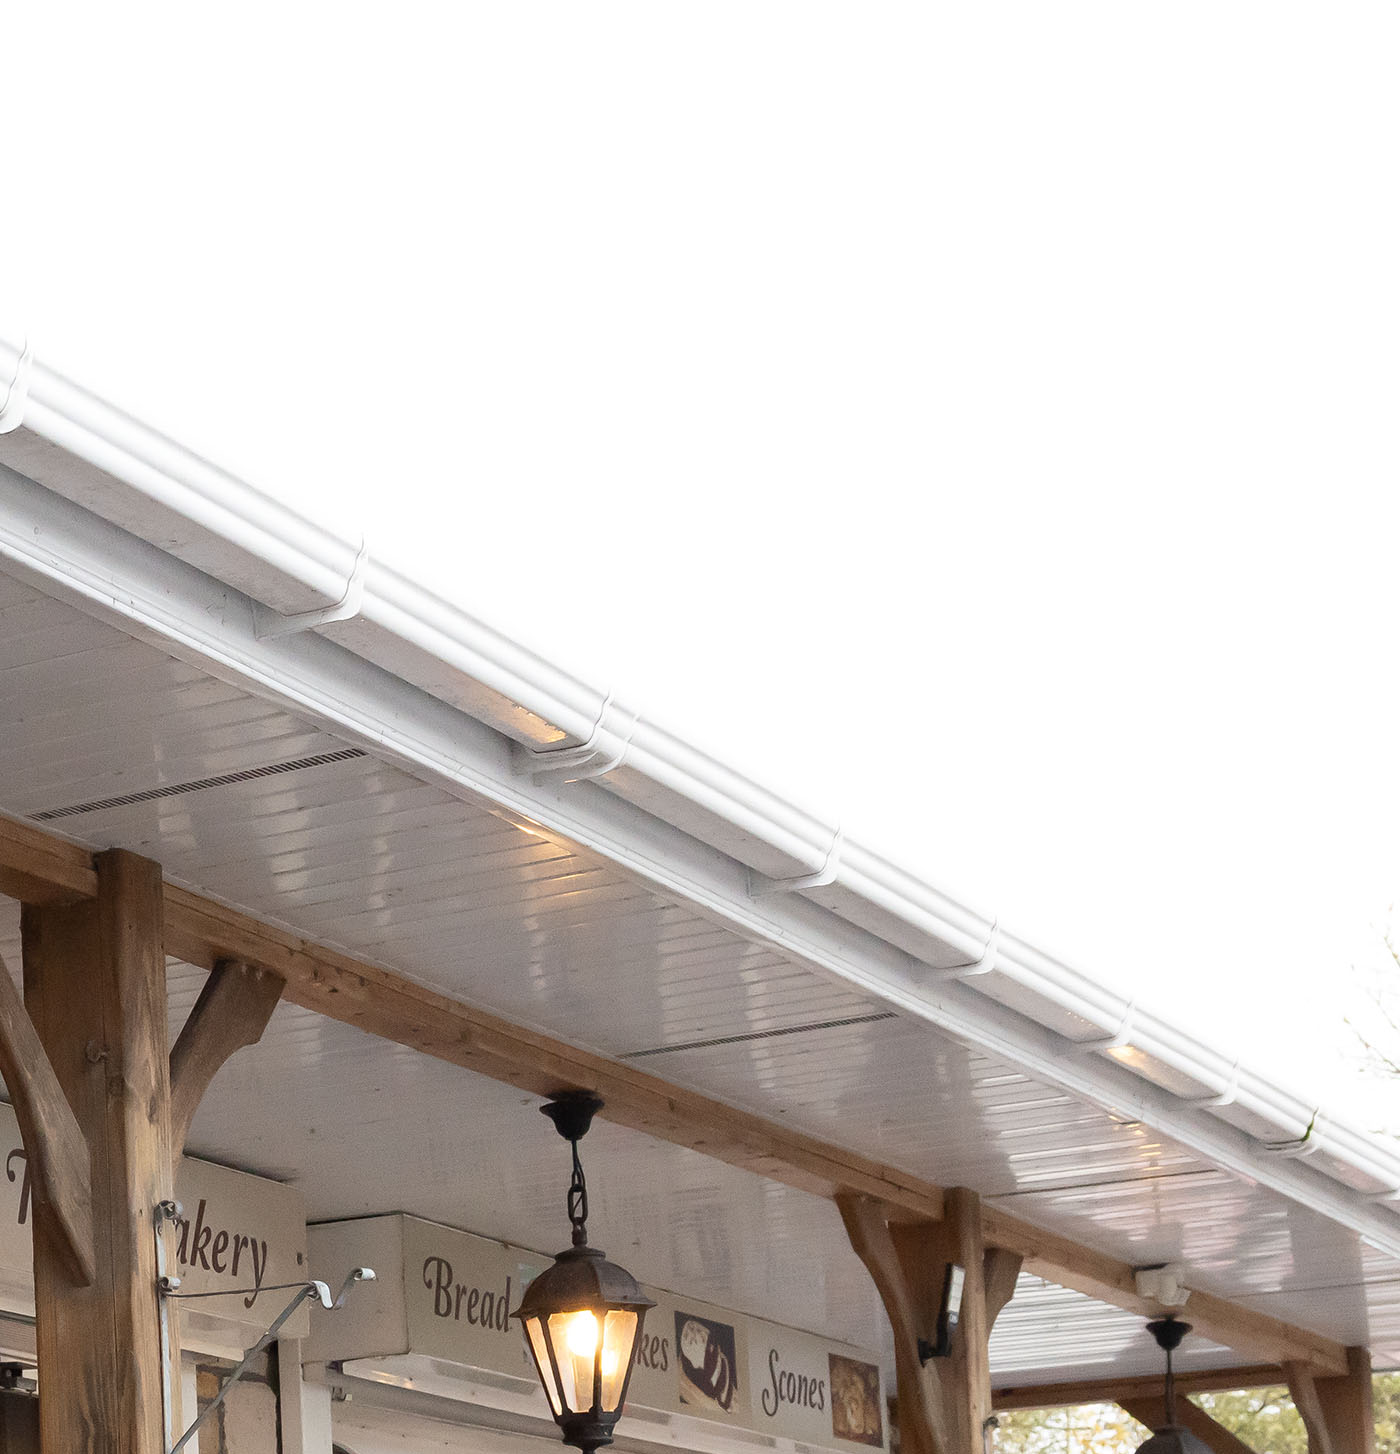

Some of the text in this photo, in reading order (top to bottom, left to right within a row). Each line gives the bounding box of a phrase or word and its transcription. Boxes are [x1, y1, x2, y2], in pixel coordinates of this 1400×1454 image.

[174, 1200, 268, 1309] akery
[423, 1256, 512, 1333] Bread
[636, 1332, 670, 1372] kes
[761, 1349, 825, 1417] Scones
